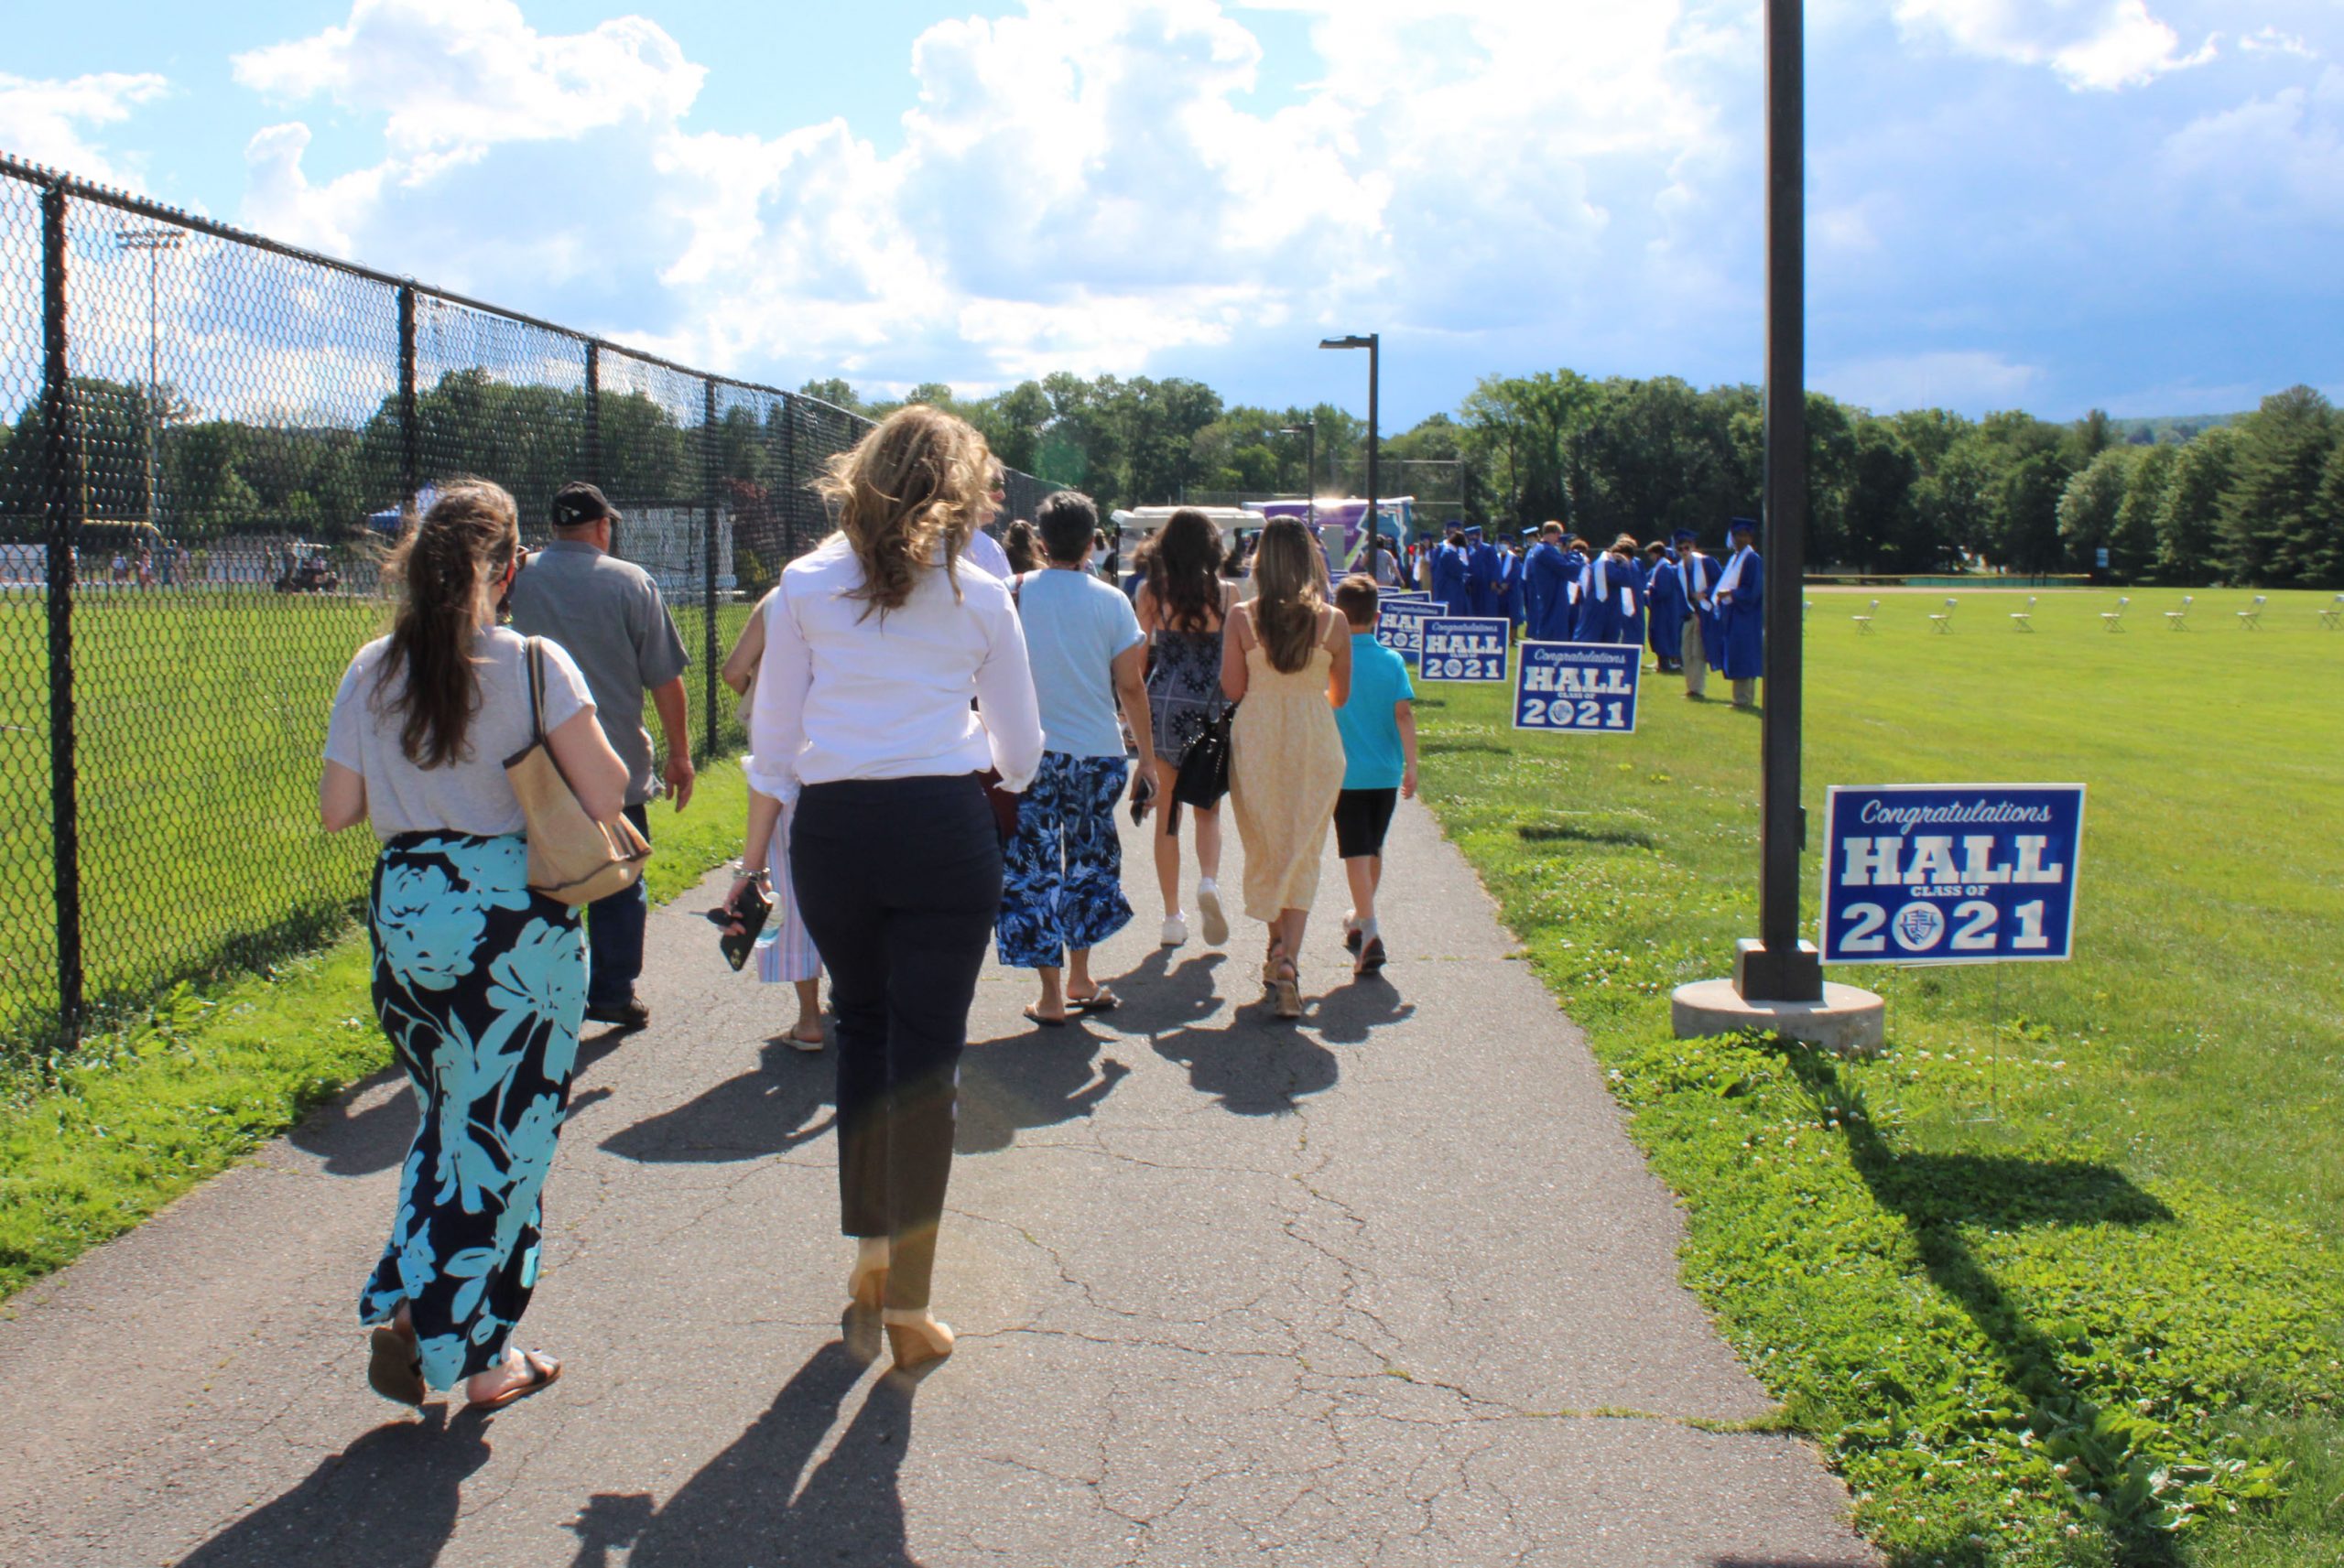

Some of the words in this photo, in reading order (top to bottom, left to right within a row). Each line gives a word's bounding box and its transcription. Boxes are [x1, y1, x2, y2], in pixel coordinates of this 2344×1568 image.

[1431, 622, 1498, 635] Congratulations
[1426, 635, 1503, 654] HALL
[1426, 658, 1500, 678] 2021
[1535, 648, 1625, 667] Congratulations
[1524, 666, 1632, 695] HALL
[1522, 698, 1625, 727] 2021
[1861, 799, 2052, 836] Congratulations
[1840, 835, 2063, 886] HALL
[1910, 885, 1961, 897] CLASS
[1965, 885, 1990, 896] OF
[1839, 899, 2049, 952] 2021
